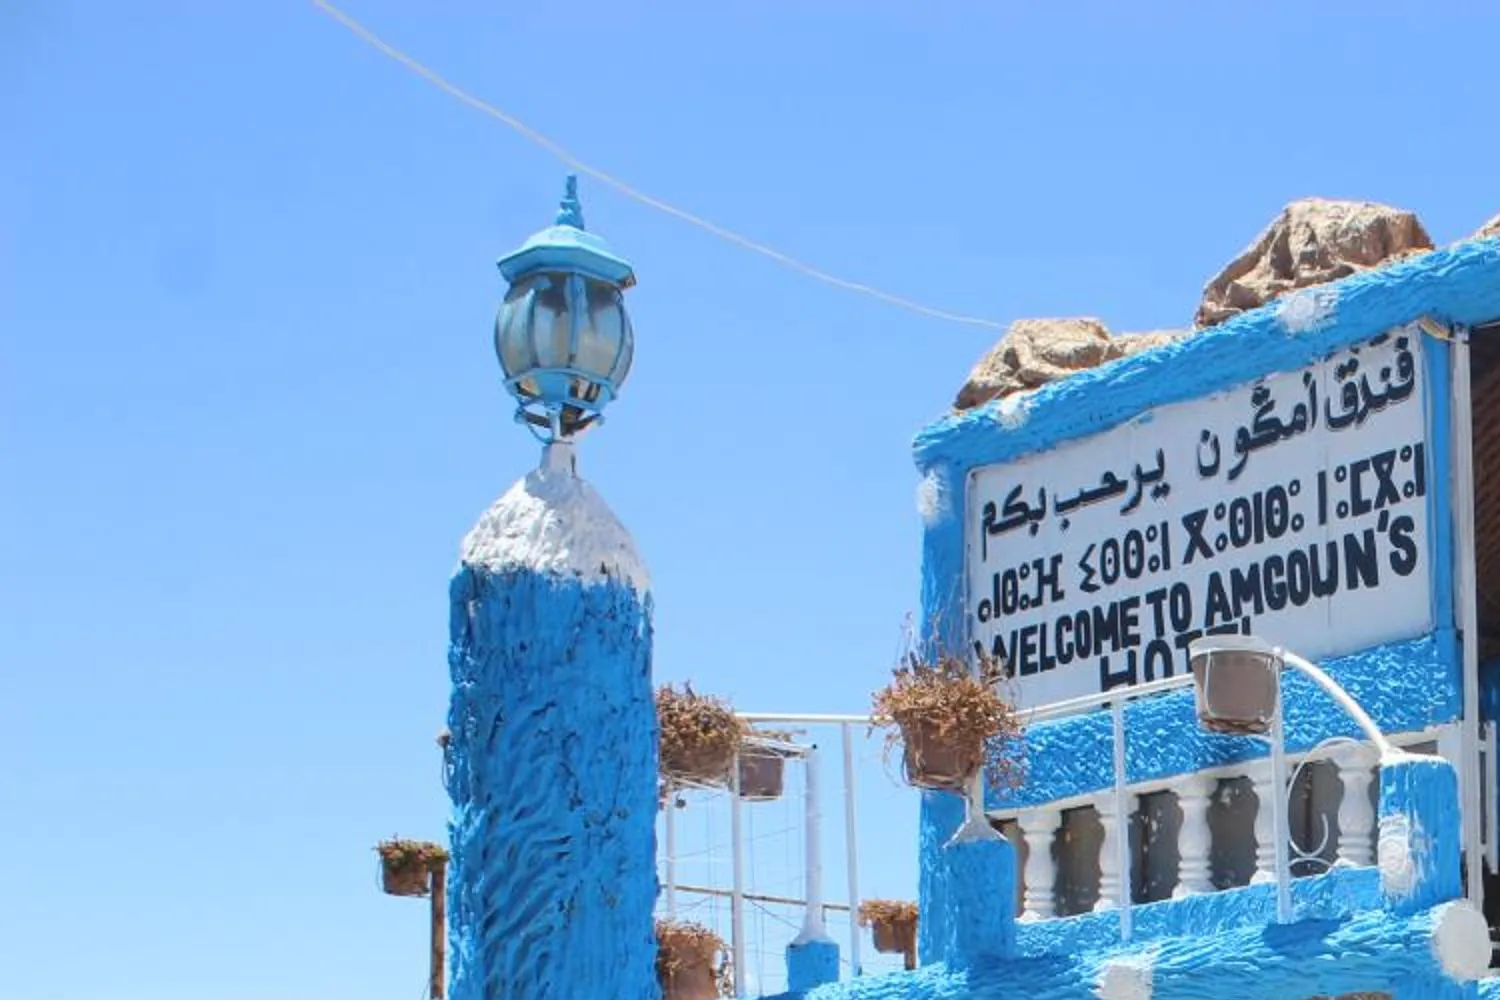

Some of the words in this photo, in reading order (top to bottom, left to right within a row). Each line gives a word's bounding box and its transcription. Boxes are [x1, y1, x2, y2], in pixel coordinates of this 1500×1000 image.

[1324, 337, 1415, 430] فندق
[982, 484, 1046, 562] بكم
[1054, 447, 1171, 532] يرحب
[975, 595, 1141, 680] WELCOME
[1145, 582, 1193, 638] TO
[1203, 509, 1418, 629] AMGOUN'S
